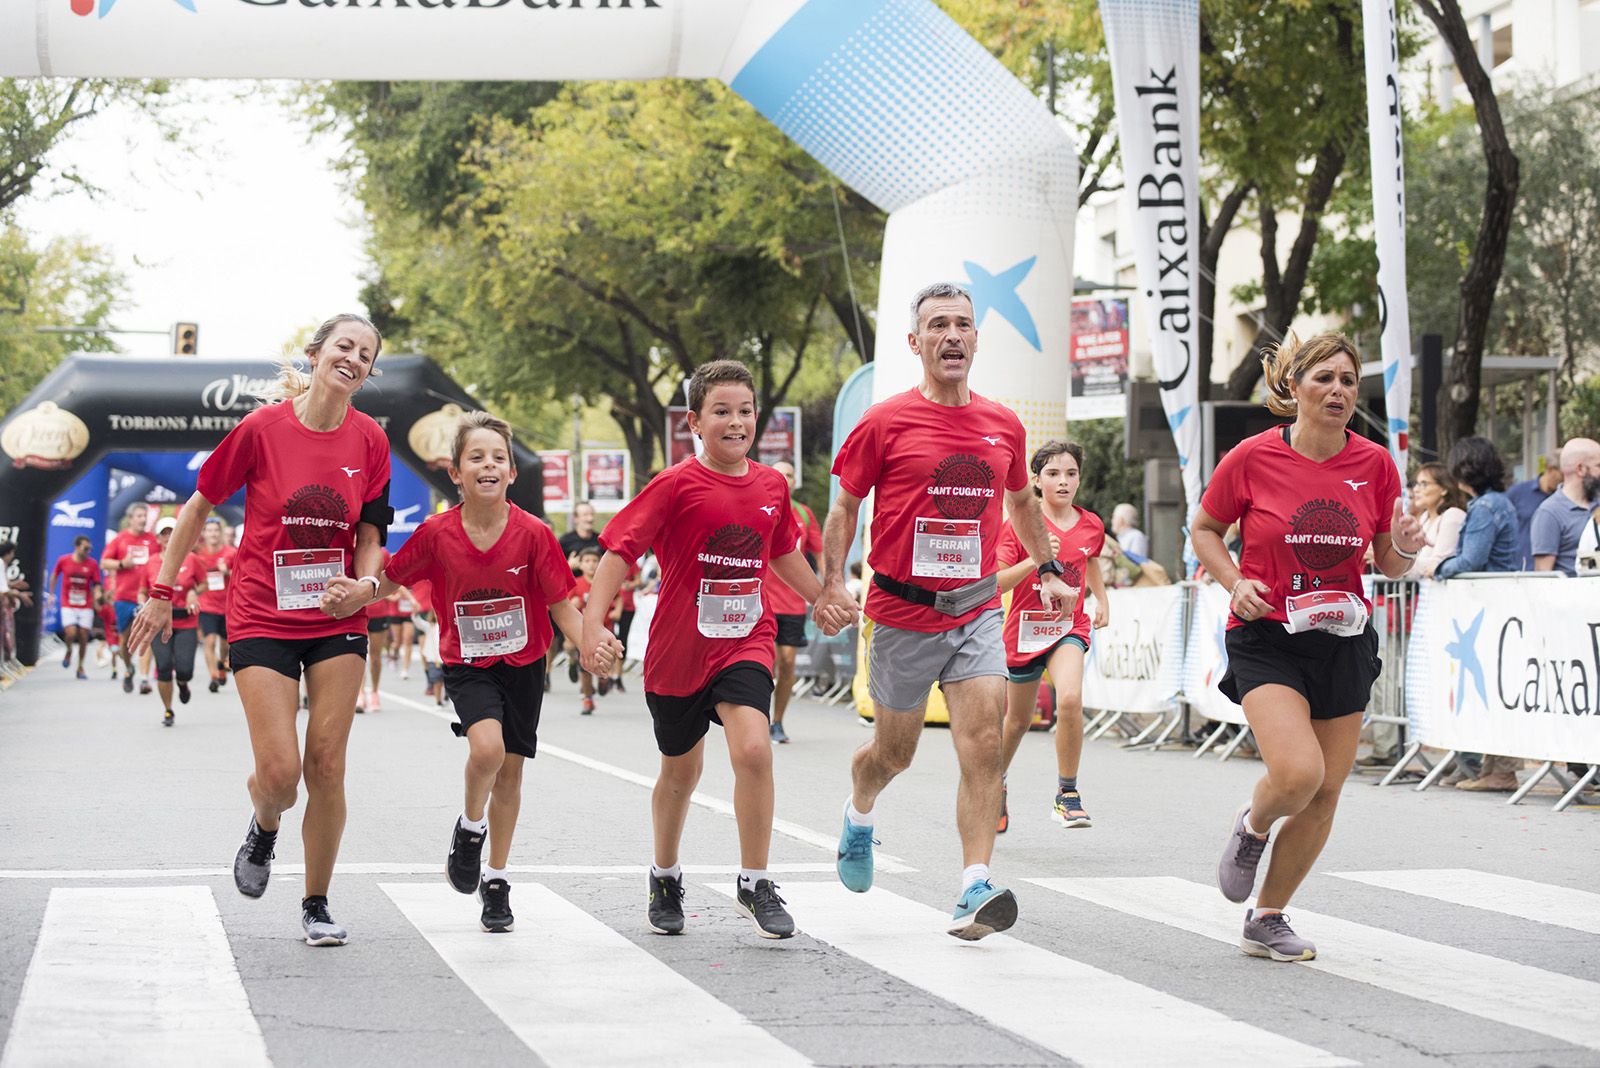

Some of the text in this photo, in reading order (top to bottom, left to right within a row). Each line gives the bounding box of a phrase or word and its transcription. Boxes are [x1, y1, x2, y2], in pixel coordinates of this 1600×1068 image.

[1135, 64, 1191, 391] CaixaBank
[109, 415, 188, 430] TORRONS
[930, 467, 941, 479] LA
[938, 453, 966, 469] CURSA
[967, 454, 979, 462] DE
[292, 484, 321, 499] CURSA
[322, 485, 336, 496] DE
[927, 486, 952, 495] SANT
[952, 487, 982, 497] CUGAT
[1288, 514, 1299, 526] LA
[1296, 498, 1327, 515] CURSA
[1328, 499, 1342, 509] DE
[281, 516, 304, 525] SANT
[305, 517, 335, 527] CUGAT
[929, 538, 970, 550] FERRAN
[1284, 534, 1312, 544] SANT
[1313, 535, 1348, 545] CUGAT
[697, 552, 723, 565] SANT
[722, 556, 753, 568] CUGAT
[936, 552, 962, 563] 1626
[290, 567, 333, 581] MARINA
[300, 582, 325, 593] 1631
[723, 599, 747, 611] POL
[472, 614, 513, 631] DÍDAC
[721, 613, 746, 623] 1627
[482, 630, 508, 641] 1634
[1032, 626, 1063, 636] 3425
